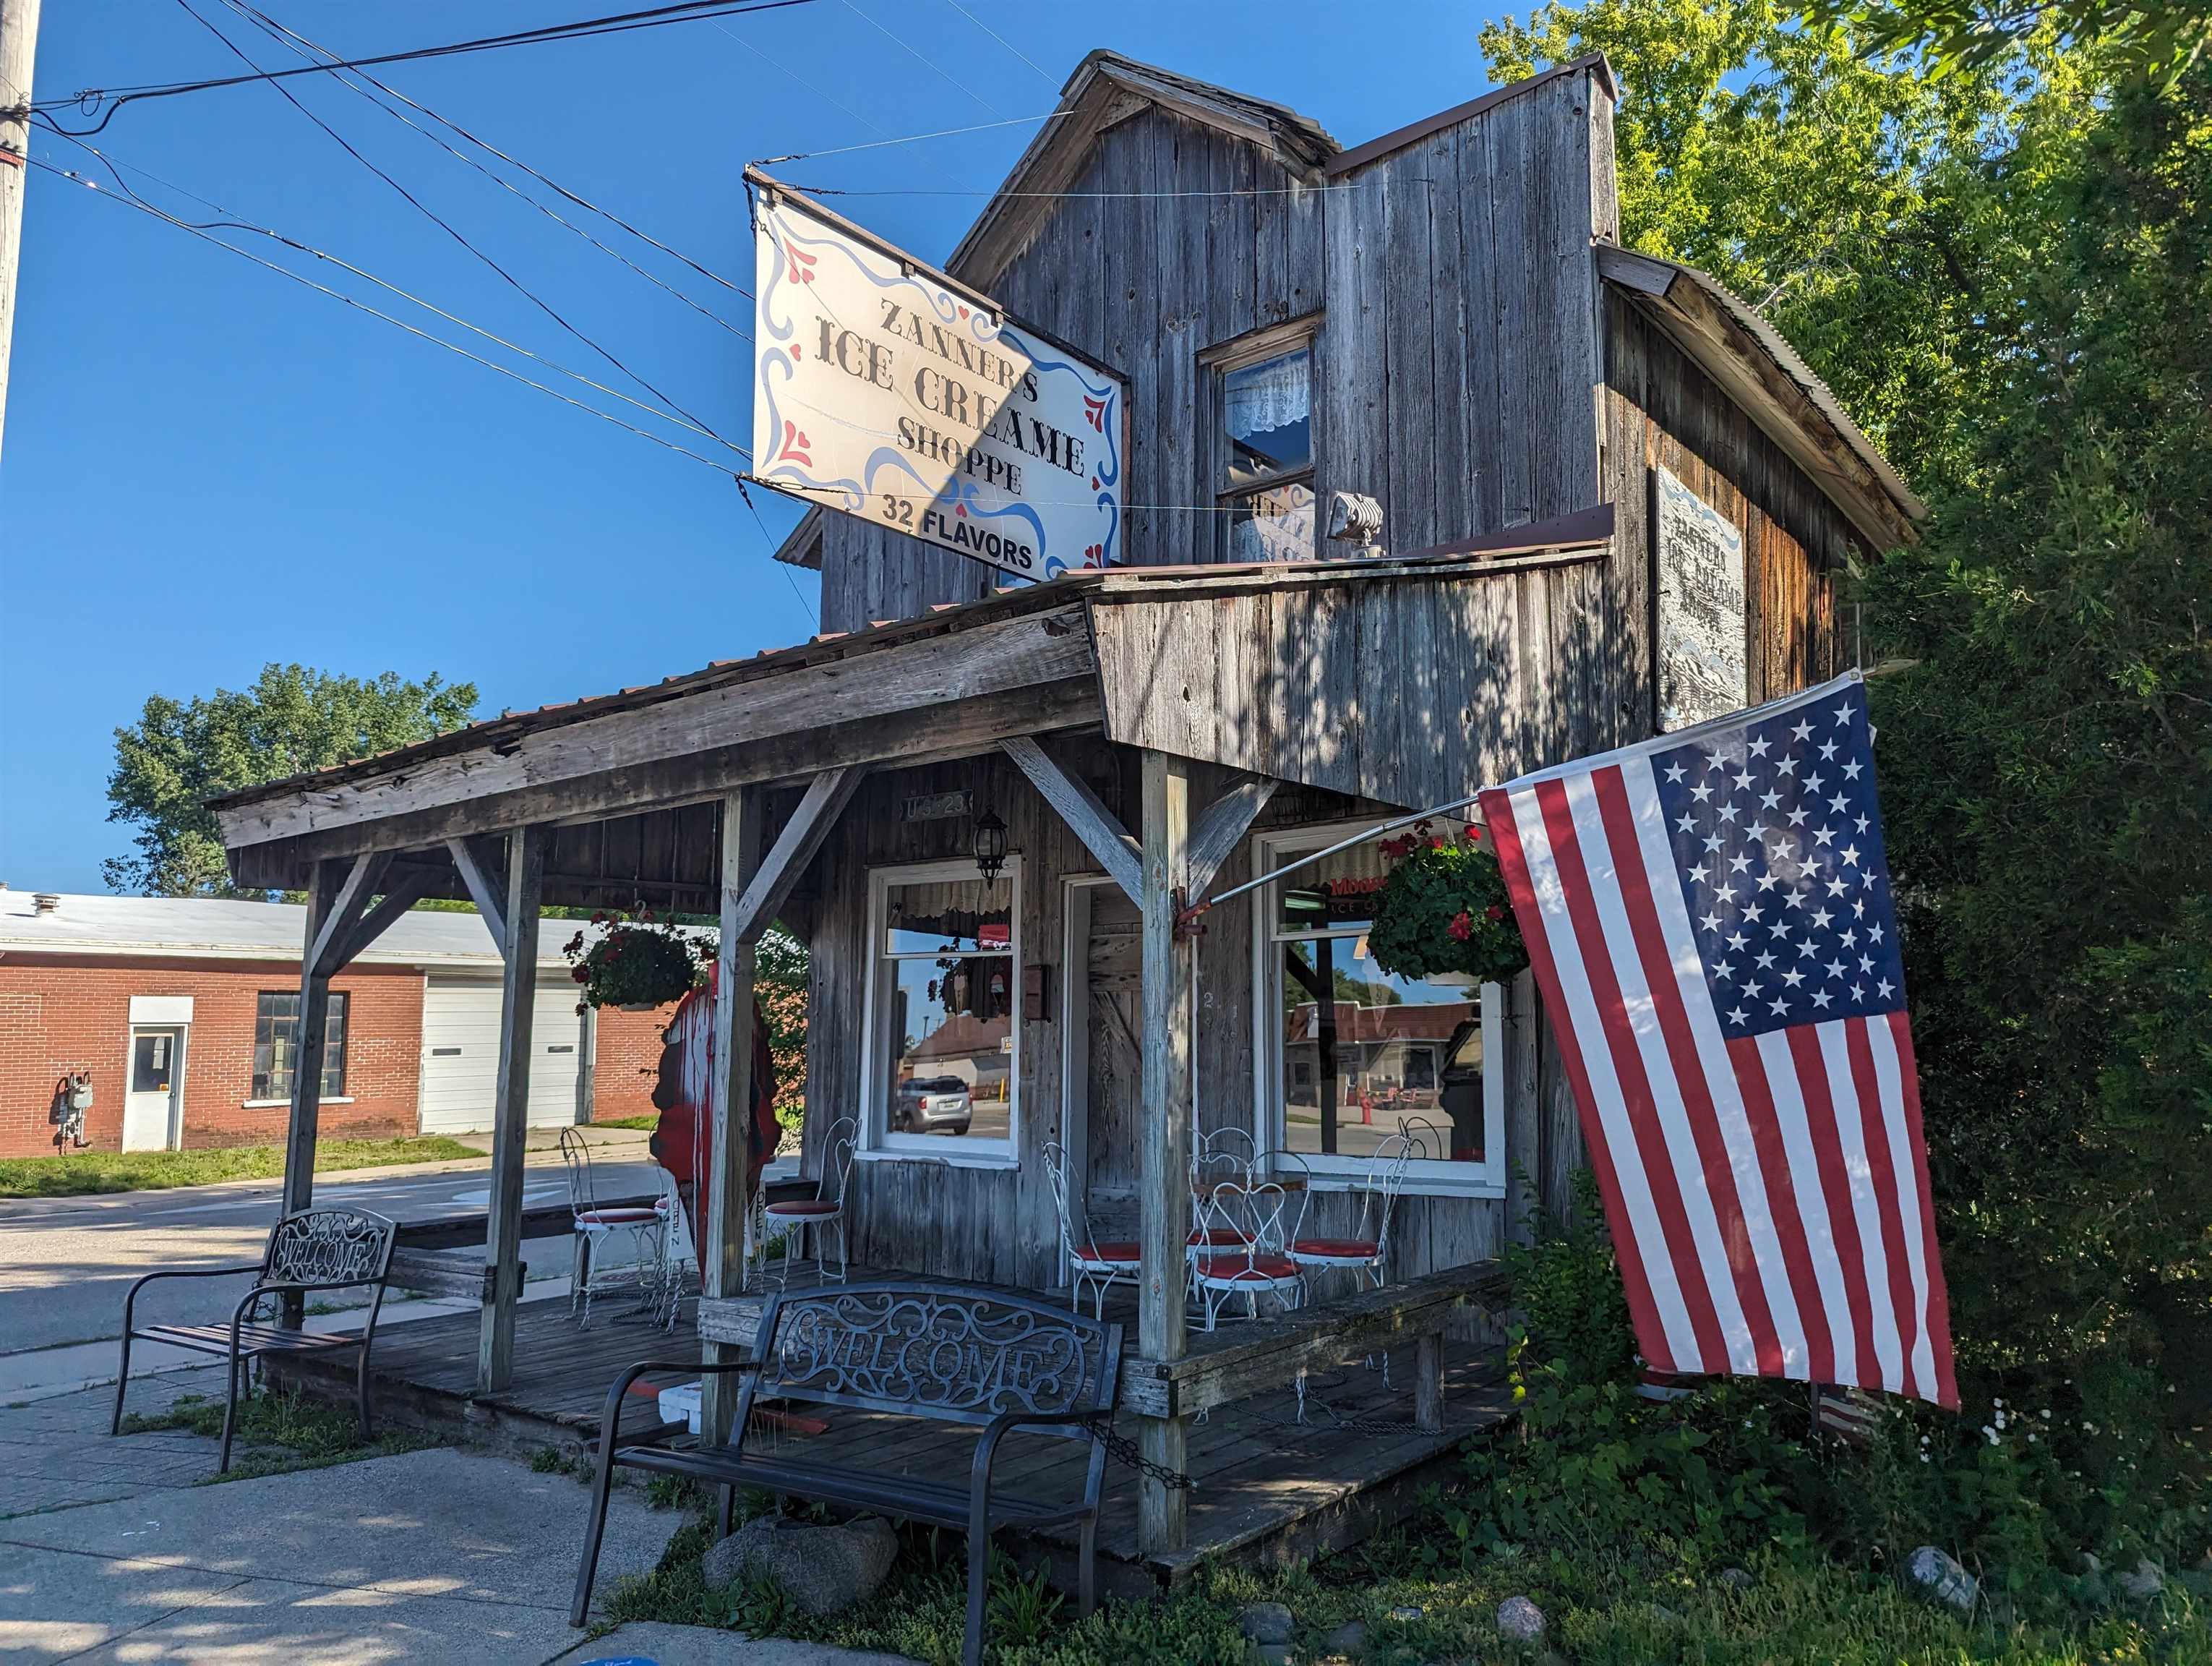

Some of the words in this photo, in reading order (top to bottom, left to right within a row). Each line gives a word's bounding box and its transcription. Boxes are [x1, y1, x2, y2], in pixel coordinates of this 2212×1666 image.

[880, 297, 1039, 402] ZANNER'S
[815, 315, 894, 391] ICE
[914, 365, 1086, 478] CREAME
[897, 414, 1023, 496] SHOPPE
[882, 493, 913, 526] 32
[923, 508, 1033, 570] FLAVORS
[283, 1237, 367, 1273] WELCOME
[810, 1325, 1045, 1395] WELCOME
